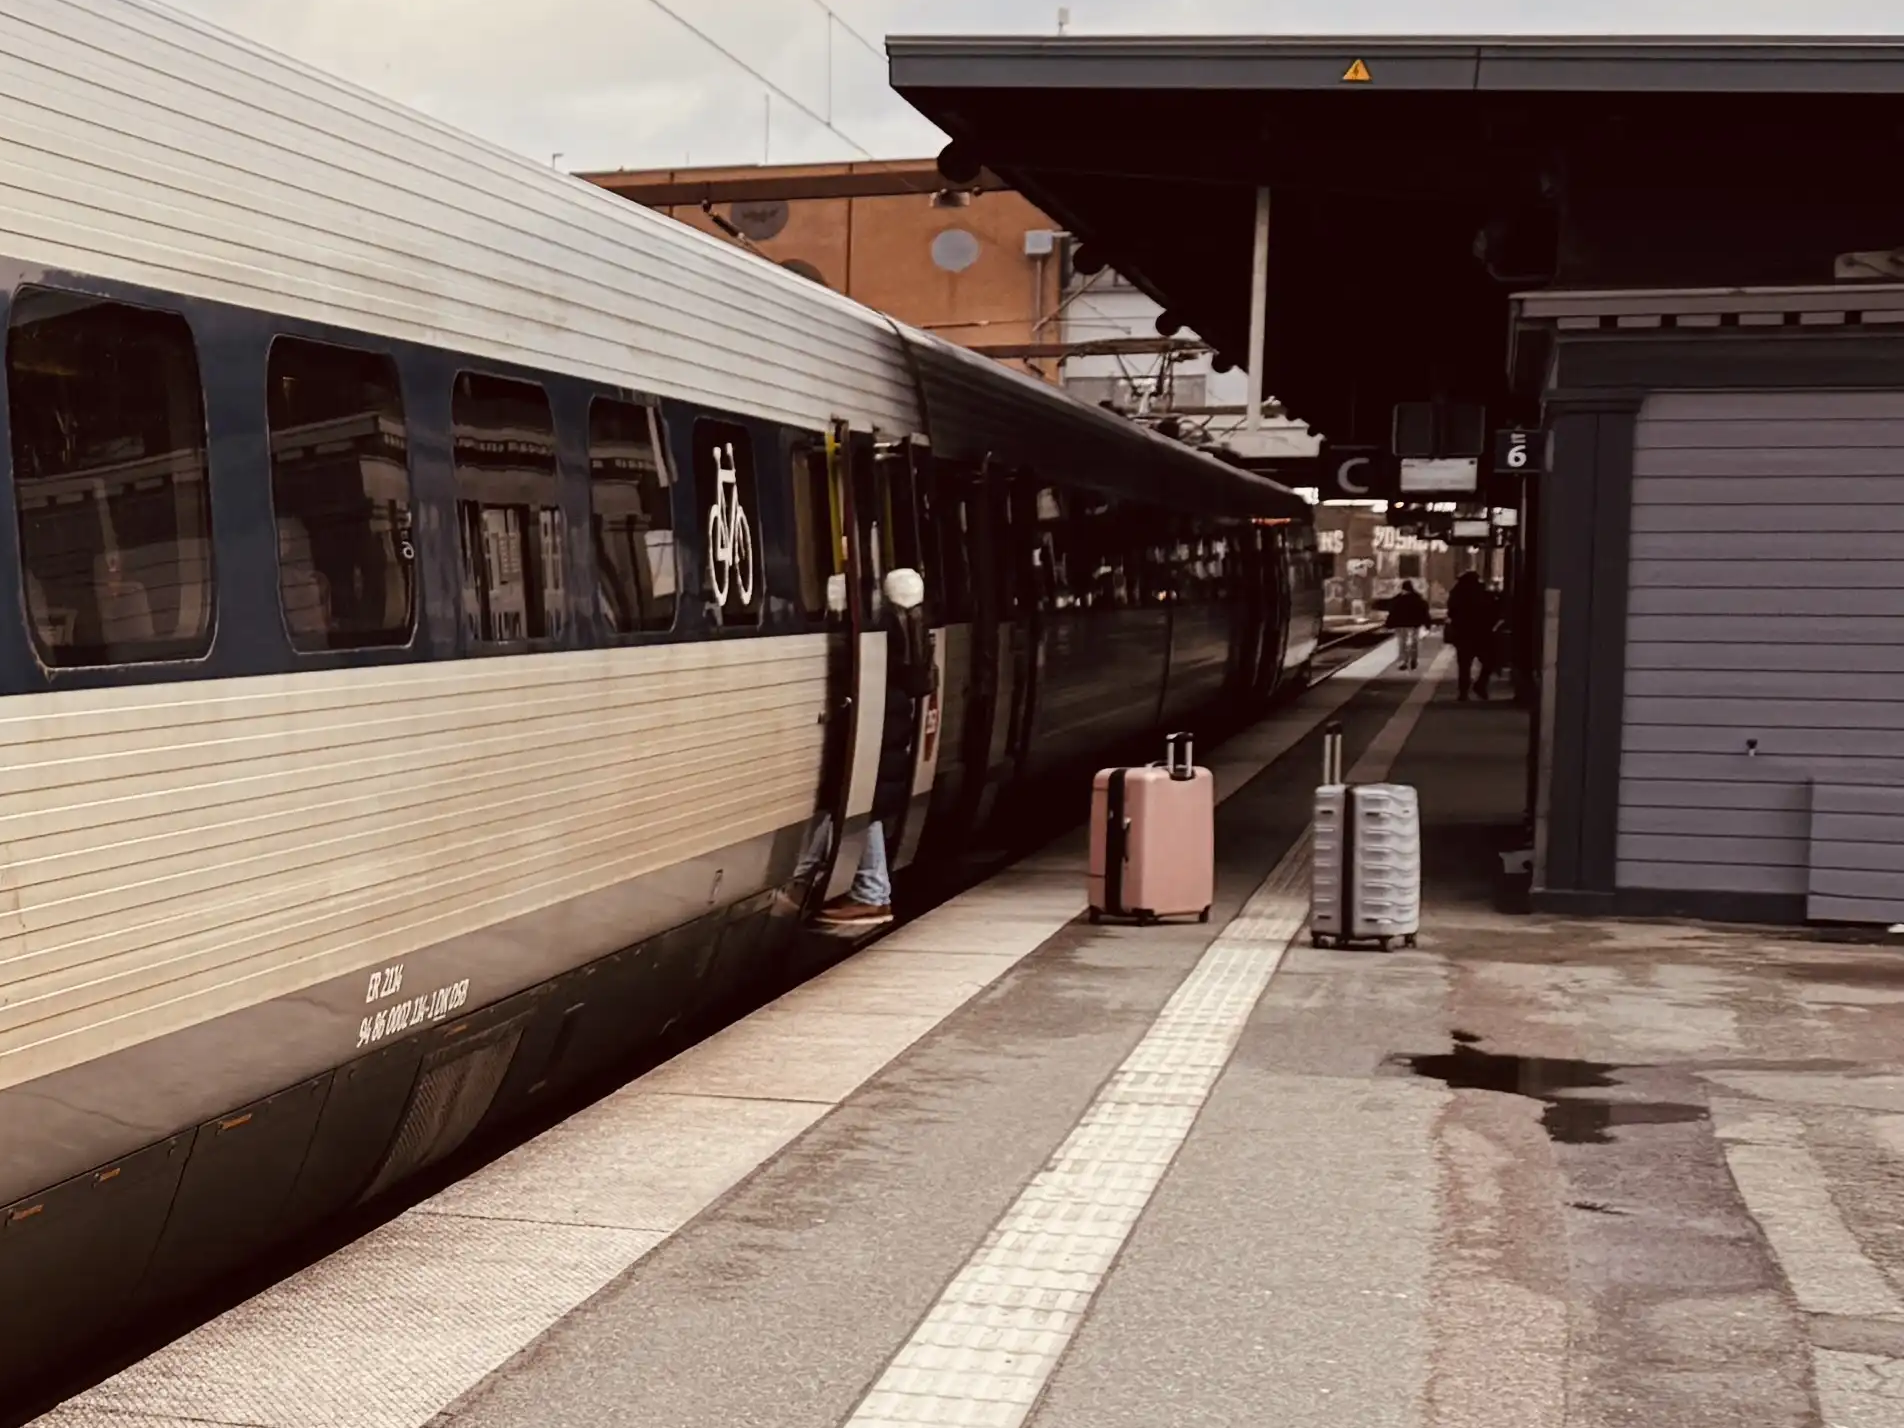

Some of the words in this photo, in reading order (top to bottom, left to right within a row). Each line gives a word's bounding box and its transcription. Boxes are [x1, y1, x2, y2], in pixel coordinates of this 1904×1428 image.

[1337, 457, 1370, 494] C
[1507, 444, 1527, 468] 6
[365, 971, 382, 1004] ER
[379, 963, 404, 998] 2114
[356, 1016, 374, 1048] 94
[371, 1009, 389, 1042] 86
[385, 1000, 412, 1036] 0002
